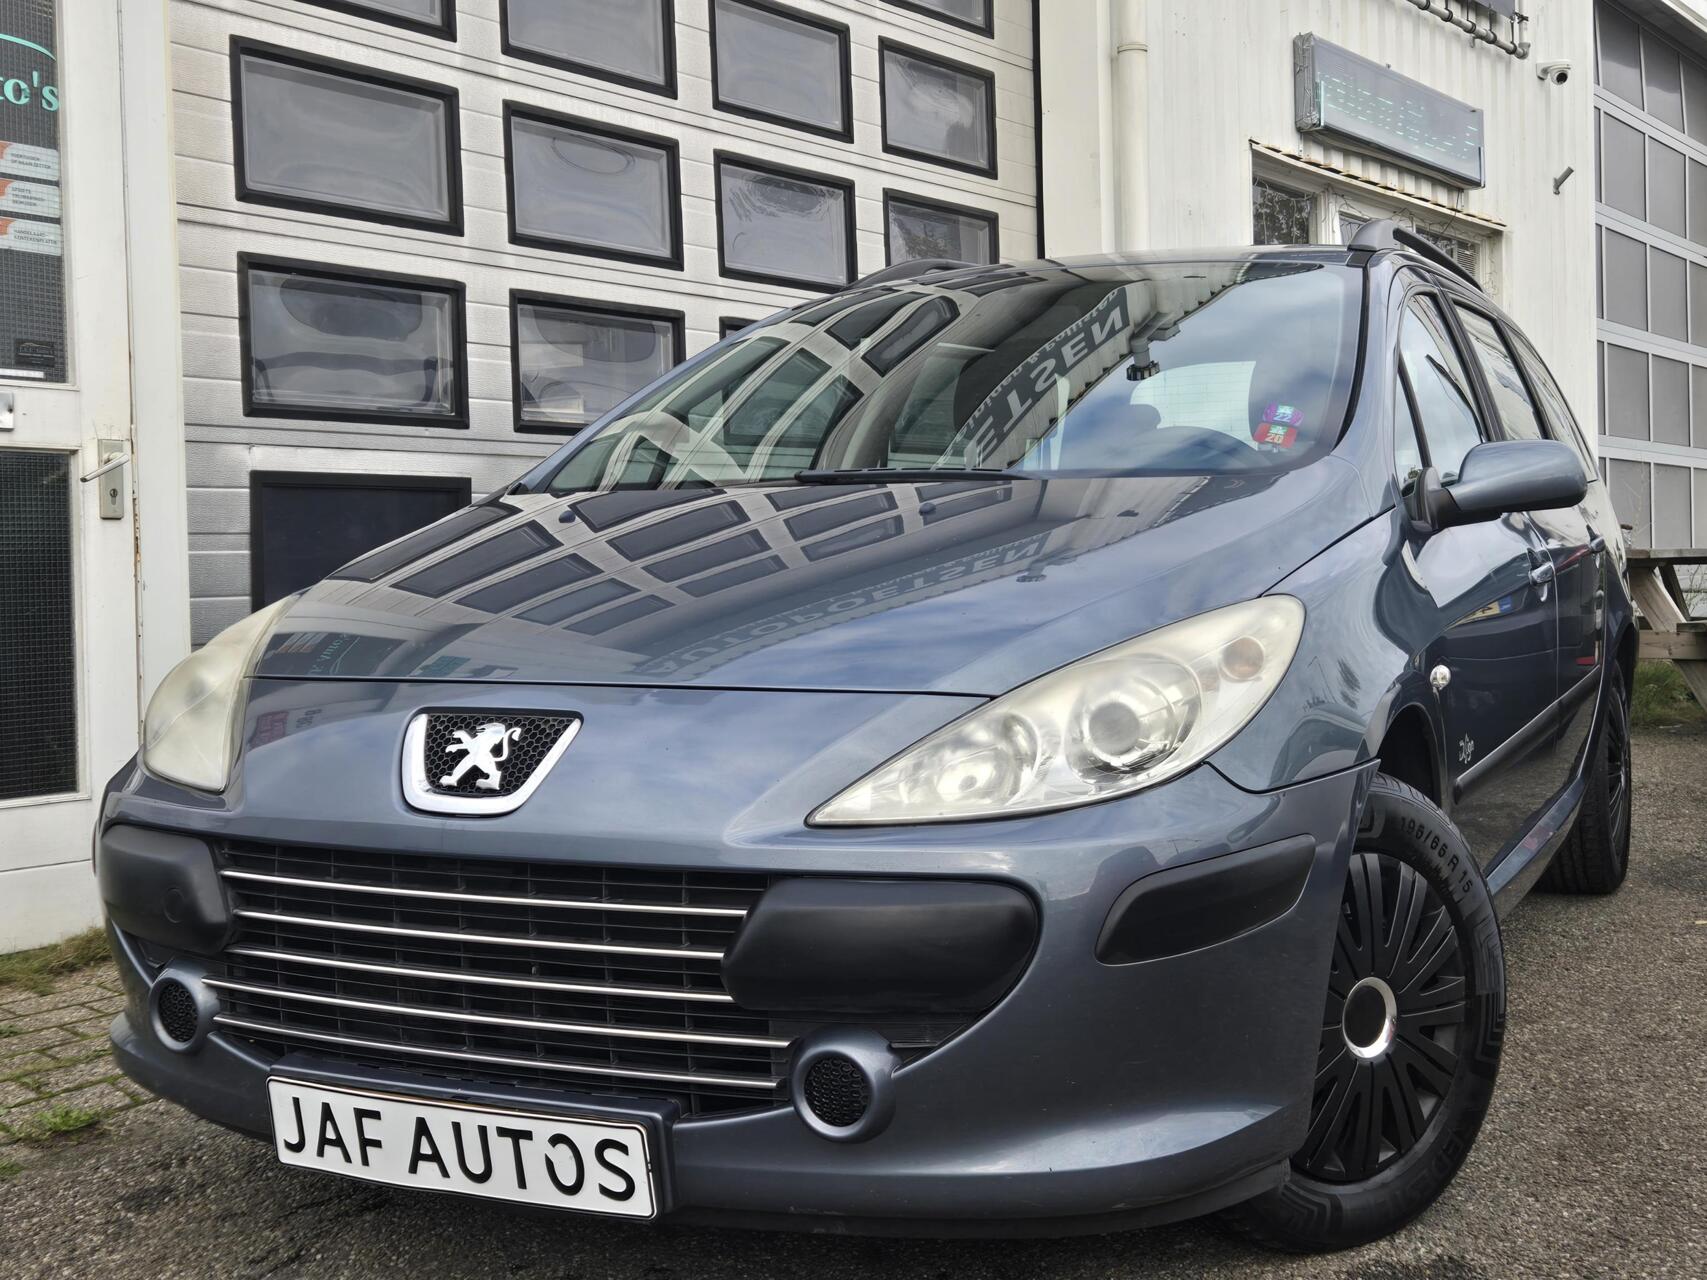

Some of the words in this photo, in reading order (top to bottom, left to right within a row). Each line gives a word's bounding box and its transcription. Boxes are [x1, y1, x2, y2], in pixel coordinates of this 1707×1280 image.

[0, 71, 59, 112] o's
[1448, 854, 1459, 872] R
[1459, 869, 1473, 893] 15
[283, 1096, 383, 1167] JAF
[408, 1116, 636, 1201] AUTOS
